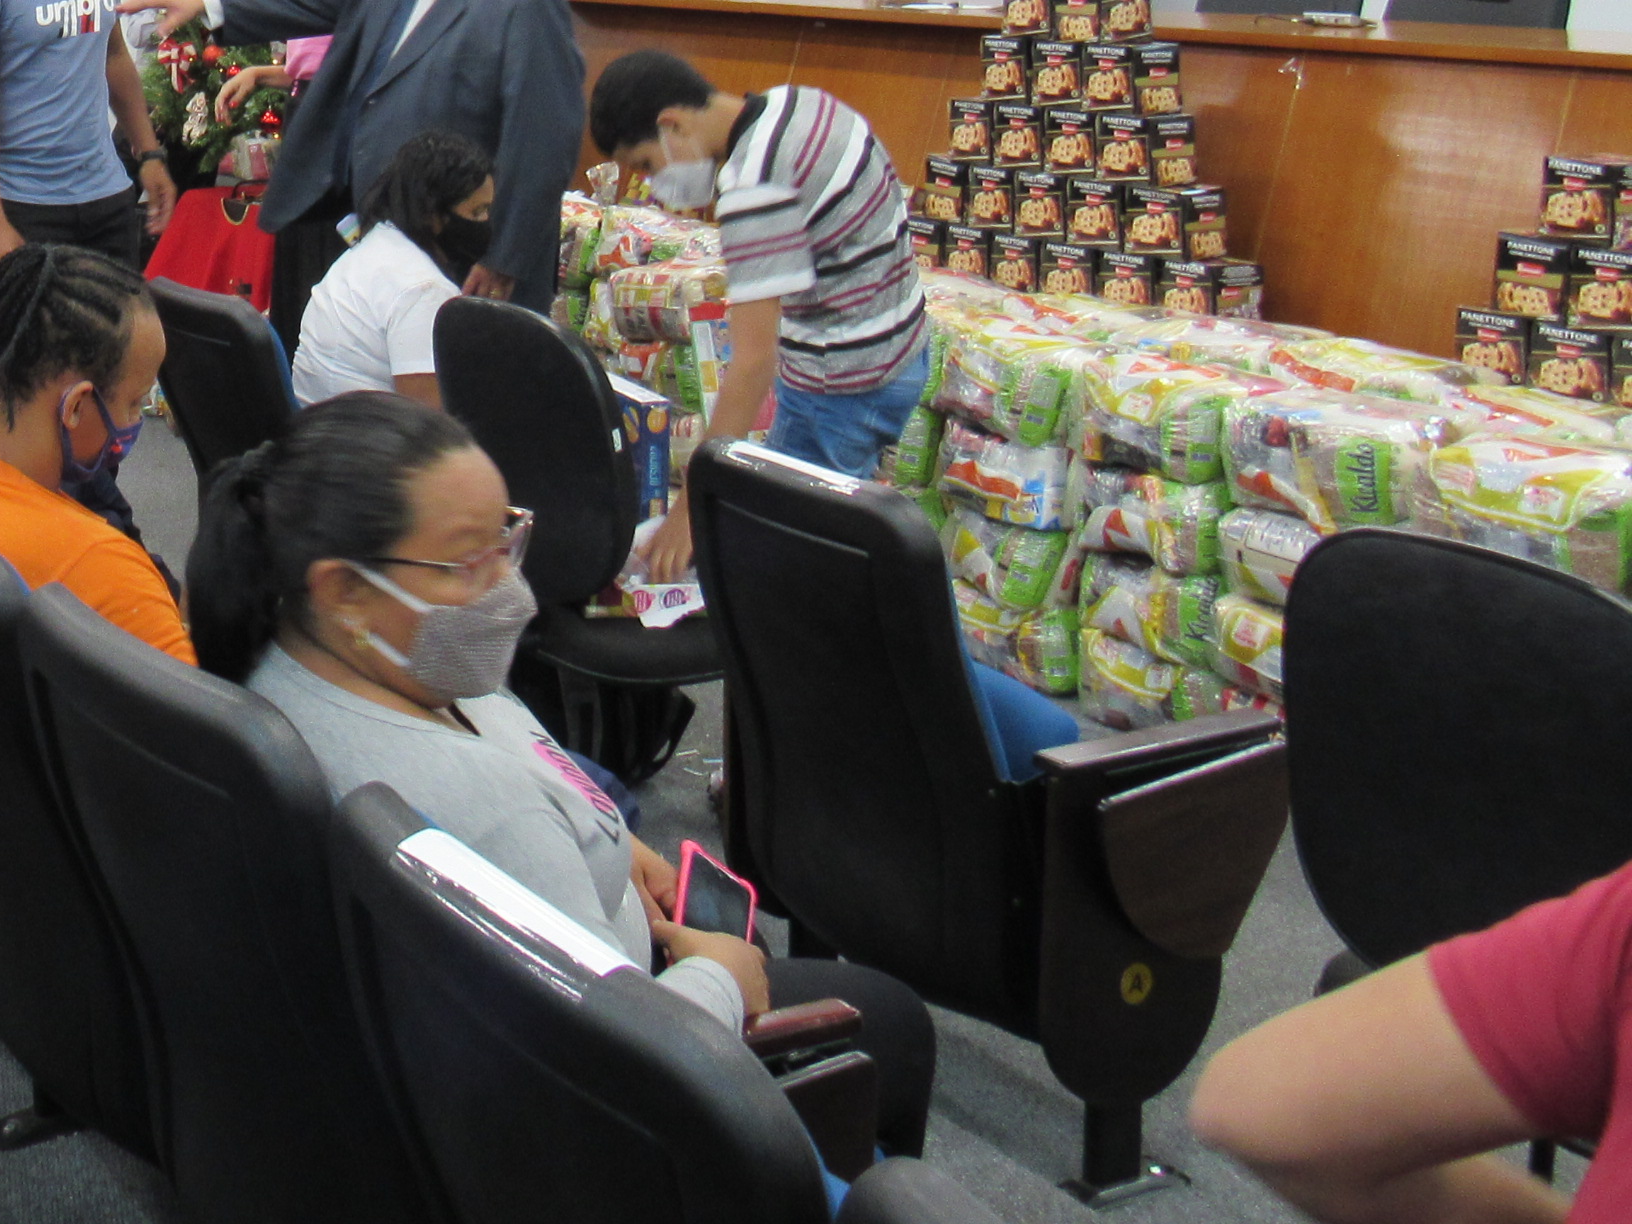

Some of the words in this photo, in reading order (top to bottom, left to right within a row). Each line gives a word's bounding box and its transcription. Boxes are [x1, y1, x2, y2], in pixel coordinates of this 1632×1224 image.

[1036, 42, 1074, 53] PANETTONE
[1087, 46, 1126, 57] PANETTONE
[998, 105, 1034, 117] PANETTONE
[1050, 110, 1088, 122] PANETTONE
[1102, 116, 1142, 128] PANETTONE
[1548, 157, 1603, 176] PANETTONE
[1073, 180, 1112, 193] PANETTONE
[1046, 243, 1085, 256] PANETTONE
[1506, 240, 1556, 257] PANETTONE
[1103, 252, 1145, 265] PANETTONE
[1164, 261, 1206, 275] PANETTONE
[1460, 311, 1516, 327] PANETTONE
[1538, 327, 1599, 344] PANETTONE
[1346, 443, 1379, 512] Kicaldo
